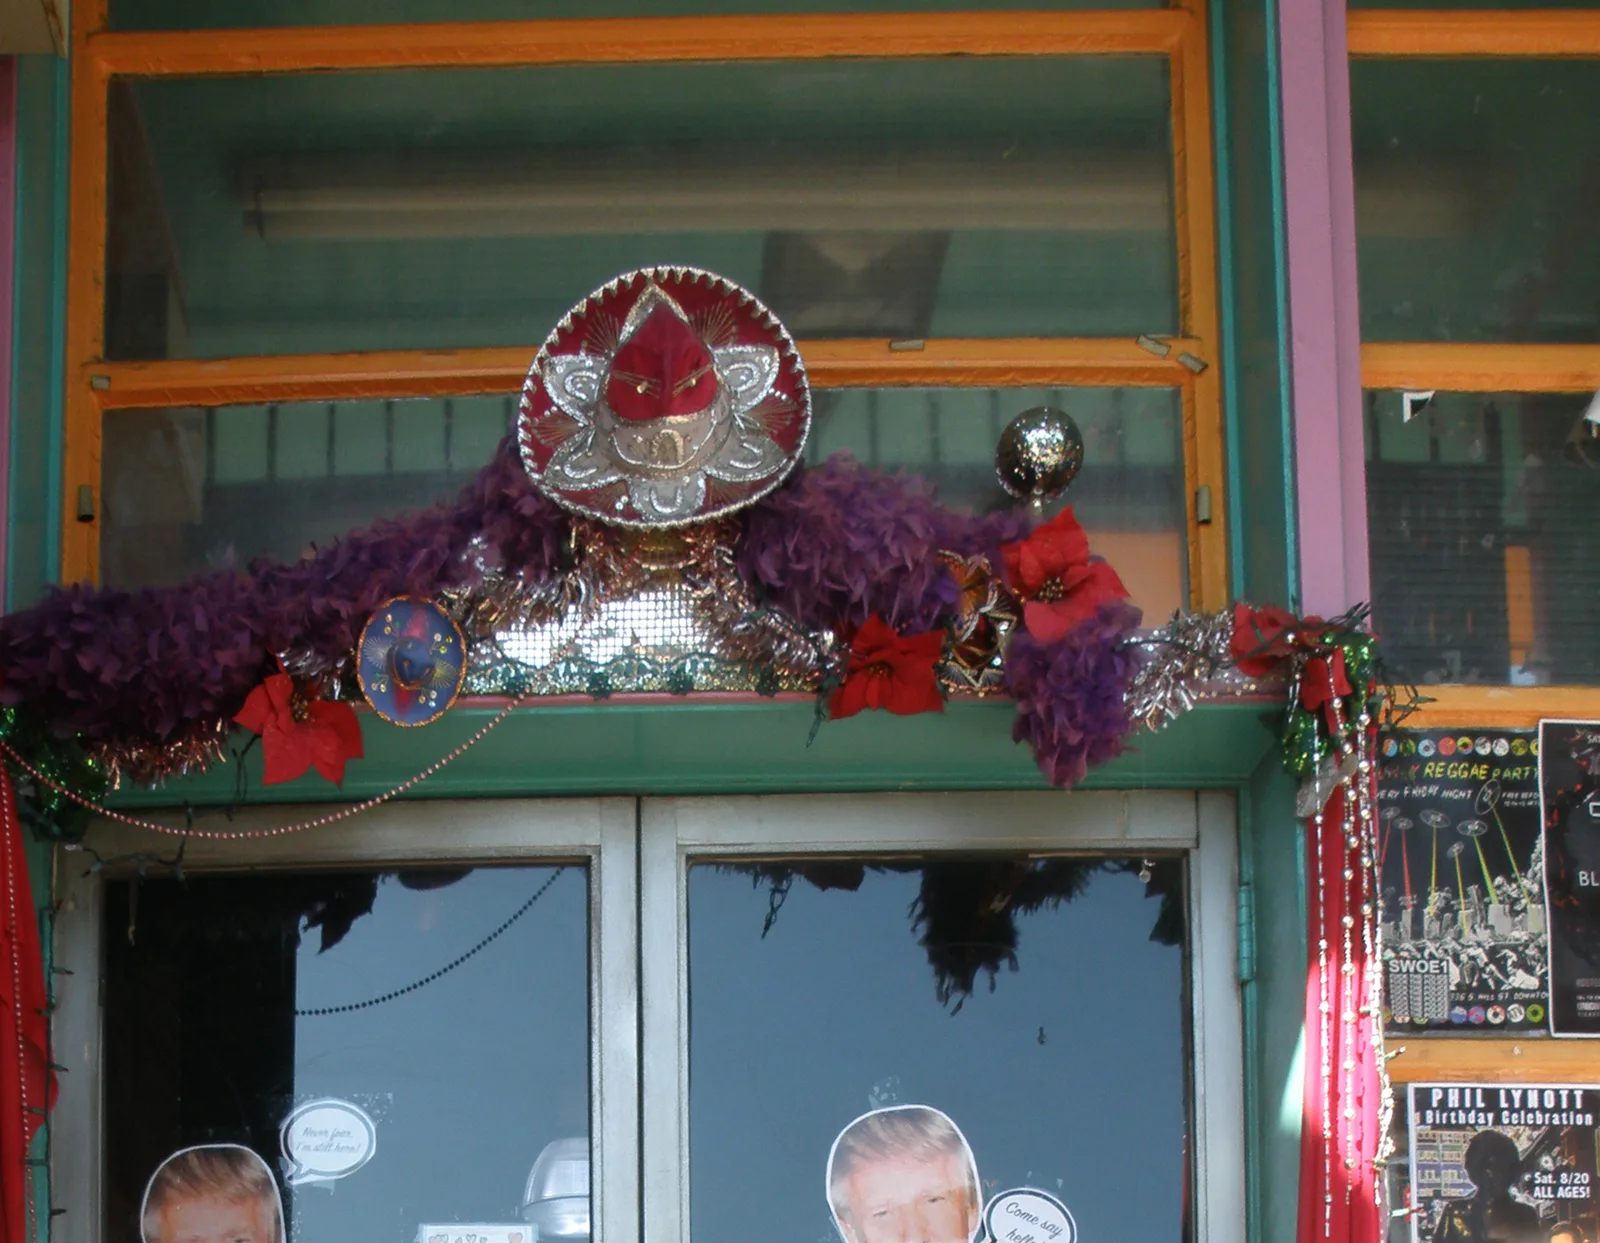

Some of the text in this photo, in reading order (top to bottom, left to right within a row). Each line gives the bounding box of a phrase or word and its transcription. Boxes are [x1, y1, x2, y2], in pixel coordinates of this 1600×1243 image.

[1423, 761, 1490, 780] REGGAE
[1389, 960, 1448, 974] SWOE1
[1431, 1088, 1584, 1110] PHIL LYNOTT
[1425, 1109, 1593, 1127] Birthday Celebration
[1533, 1172, 1590, 1185] Sat. 8/20
[1533, 1186, 1590, 1199] ALL AGES!
[1005, 1201, 1063, 1240] Come say
